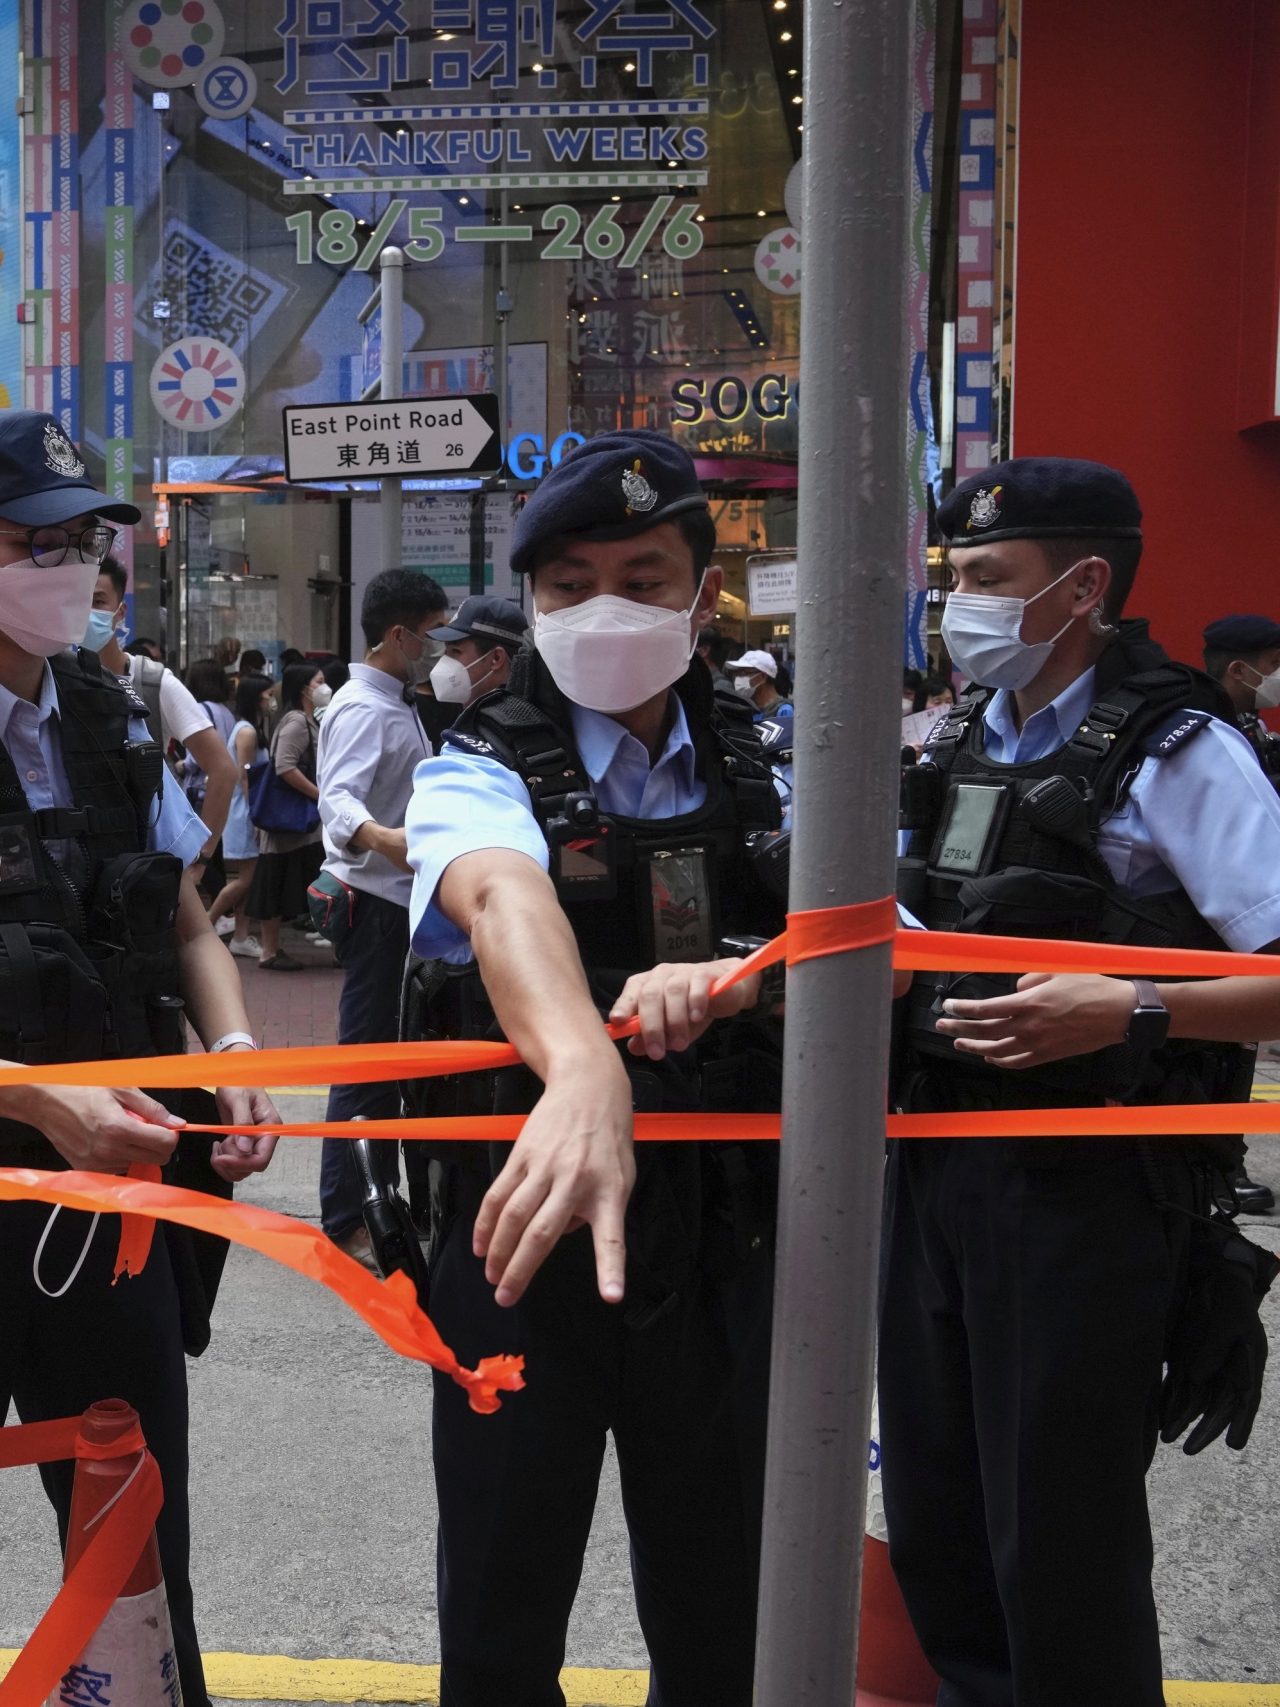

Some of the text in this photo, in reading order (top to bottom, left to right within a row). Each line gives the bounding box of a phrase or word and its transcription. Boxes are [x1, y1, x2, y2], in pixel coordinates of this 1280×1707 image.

[283, 126, 709, 168] THANKFUL WEEKS
[671, 374, 800, 426] SOG
[291, 409, 463, 436] East Point Road
[336, 440, 464, 468] 東角道 26
[118, 679, 145, 706] 22819
[1159, 718, 1199, 749] 27834
[943, 847, 971, 860] 27834
[666, 934, 698, 950] 2018
